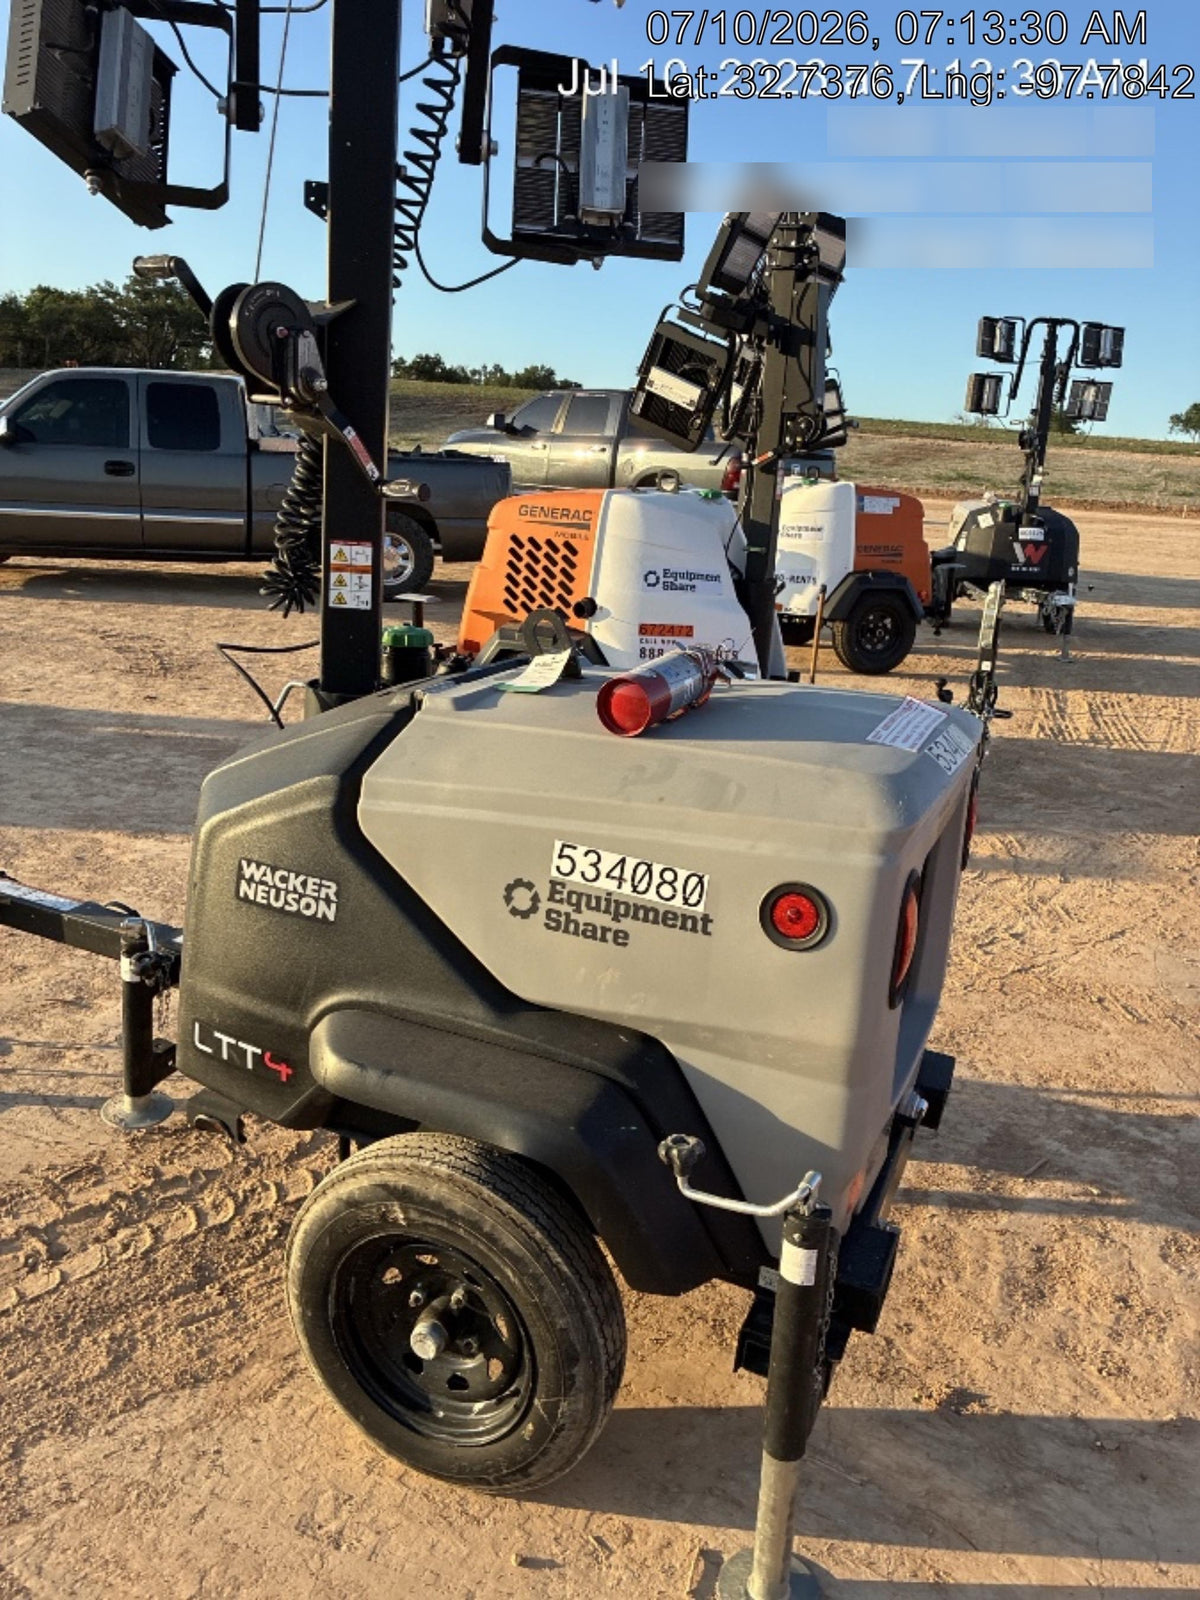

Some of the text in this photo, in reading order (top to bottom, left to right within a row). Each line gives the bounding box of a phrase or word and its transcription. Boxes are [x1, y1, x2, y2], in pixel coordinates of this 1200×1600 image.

[518, 504, 593, 522] GENERAC
[662, 568, 721, 583] Equipment
[662, 580, 697, 593] Share
[240, 858, 339, 902] WACKER
[555, 842, 706, 908] 534080
[238, 880, 338, 922] NEUSON
[547, 879, 714, 936] Equipment
[543, 907, 631, 948] Share
[193, 1021, 294, 1083] LTT4
